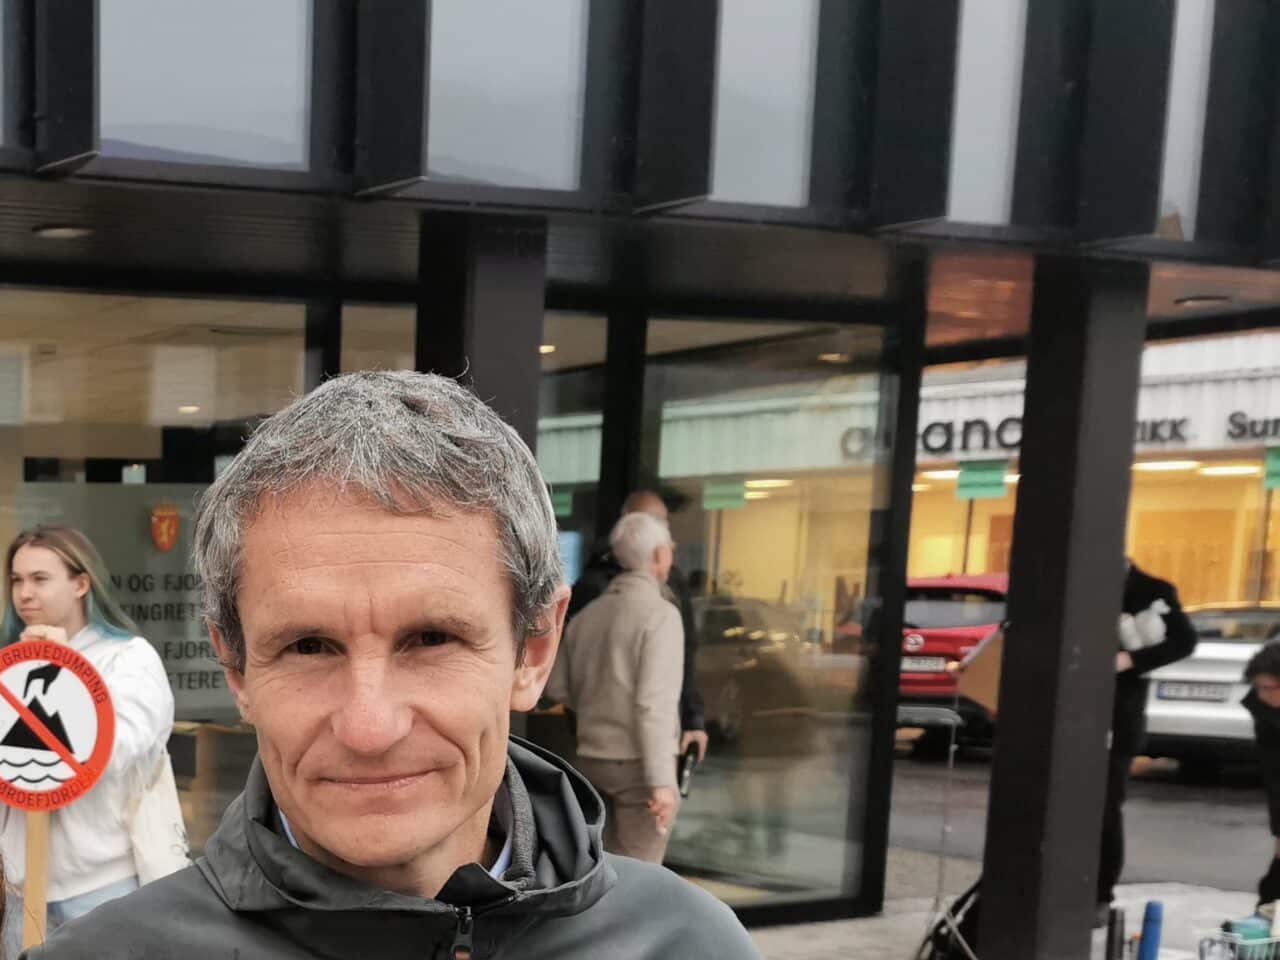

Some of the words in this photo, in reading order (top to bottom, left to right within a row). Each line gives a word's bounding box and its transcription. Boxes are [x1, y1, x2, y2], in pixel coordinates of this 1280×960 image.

[127, 574, 154, 592] OG
[164, 641, 218, 660] FJOR
[2, 644, 108, 705] GRUVEDUMPING
